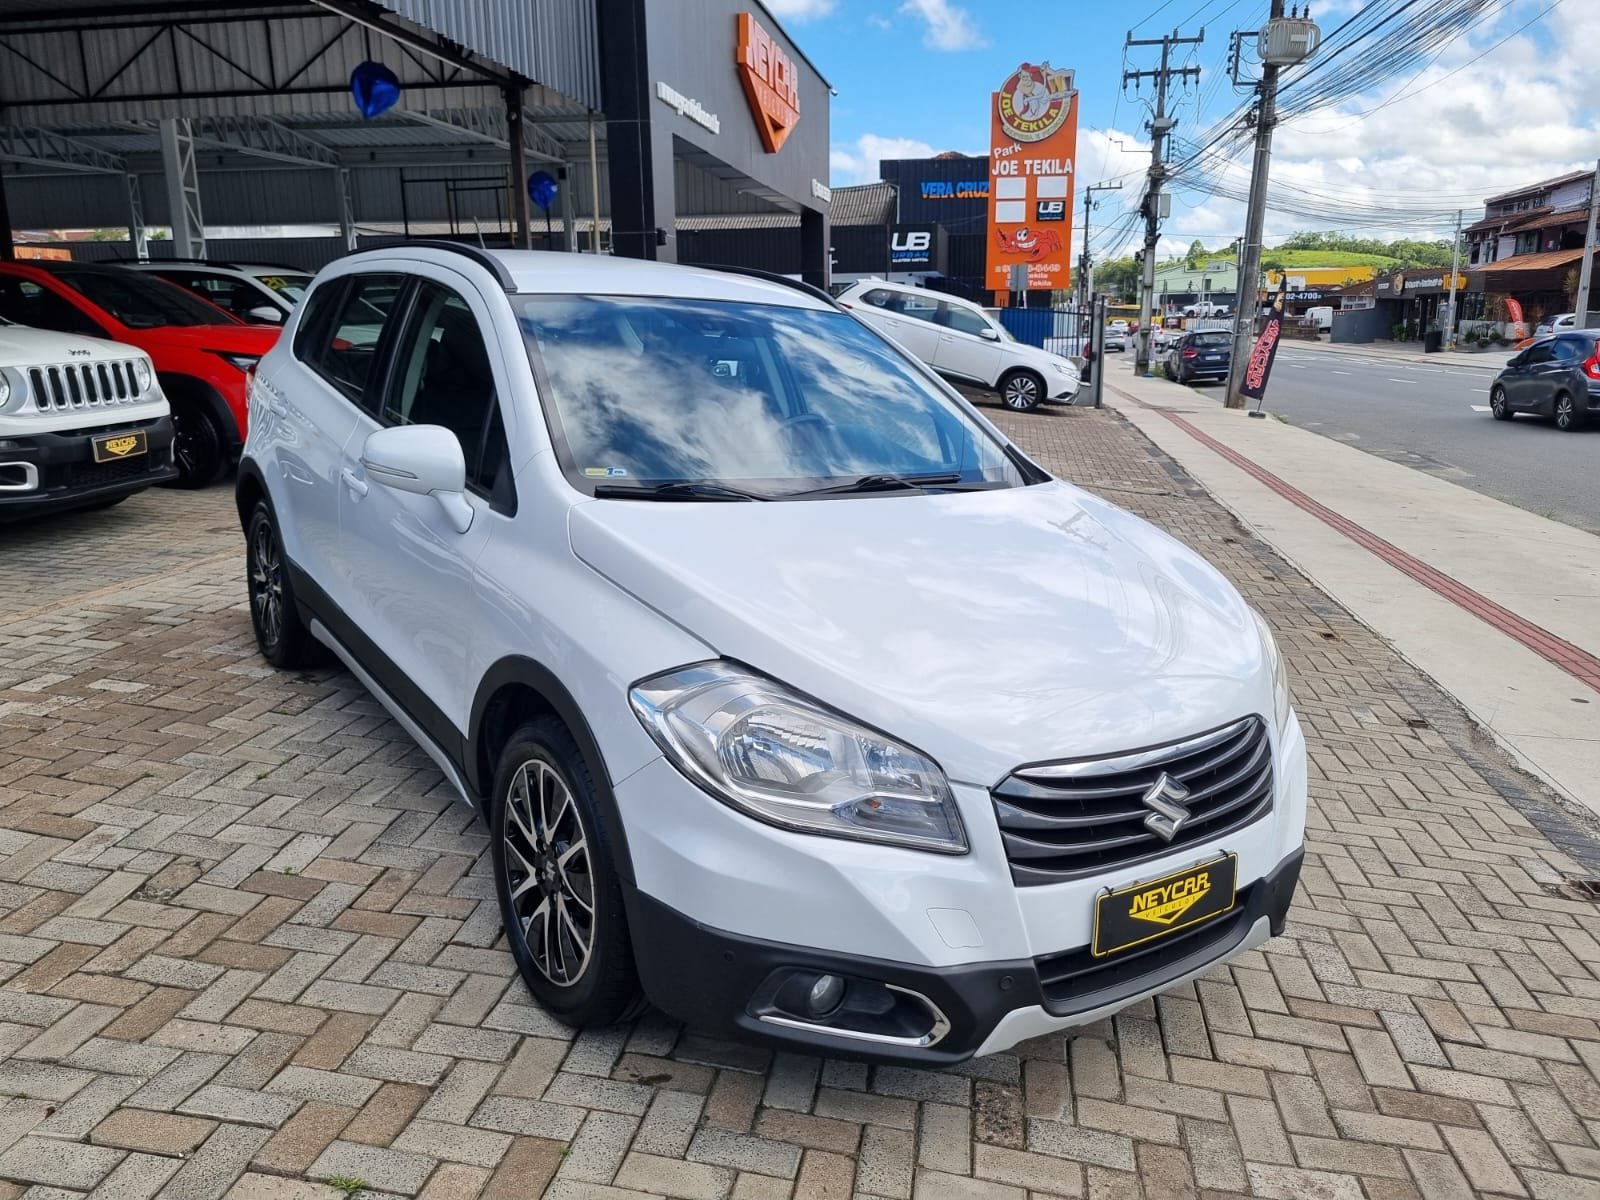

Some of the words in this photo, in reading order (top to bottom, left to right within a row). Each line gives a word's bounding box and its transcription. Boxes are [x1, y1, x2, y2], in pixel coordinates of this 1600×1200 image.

[746, 12, 800, 114] NEYCAR
[1002, 91, 1014, 118] JOE
[1012, 108, 1059, 131] TEKILA
[993, 143, 1022, 159] Park
[992, 160, 1019, 175] JOE
[1024, 158, 1073, 175] TEKILA
[920, 181, 954, 199] VERA
[956, 181, 990, 199] CRUZ
[1039, 201, 1064, 213] UB
[891, 231, 931, 251] UB
[1251, 319, 1280, 389] NEYCAR
[105, 436, 138, 449] NEYCAR
[1129, 871, 1211, 915] NEYCAR
